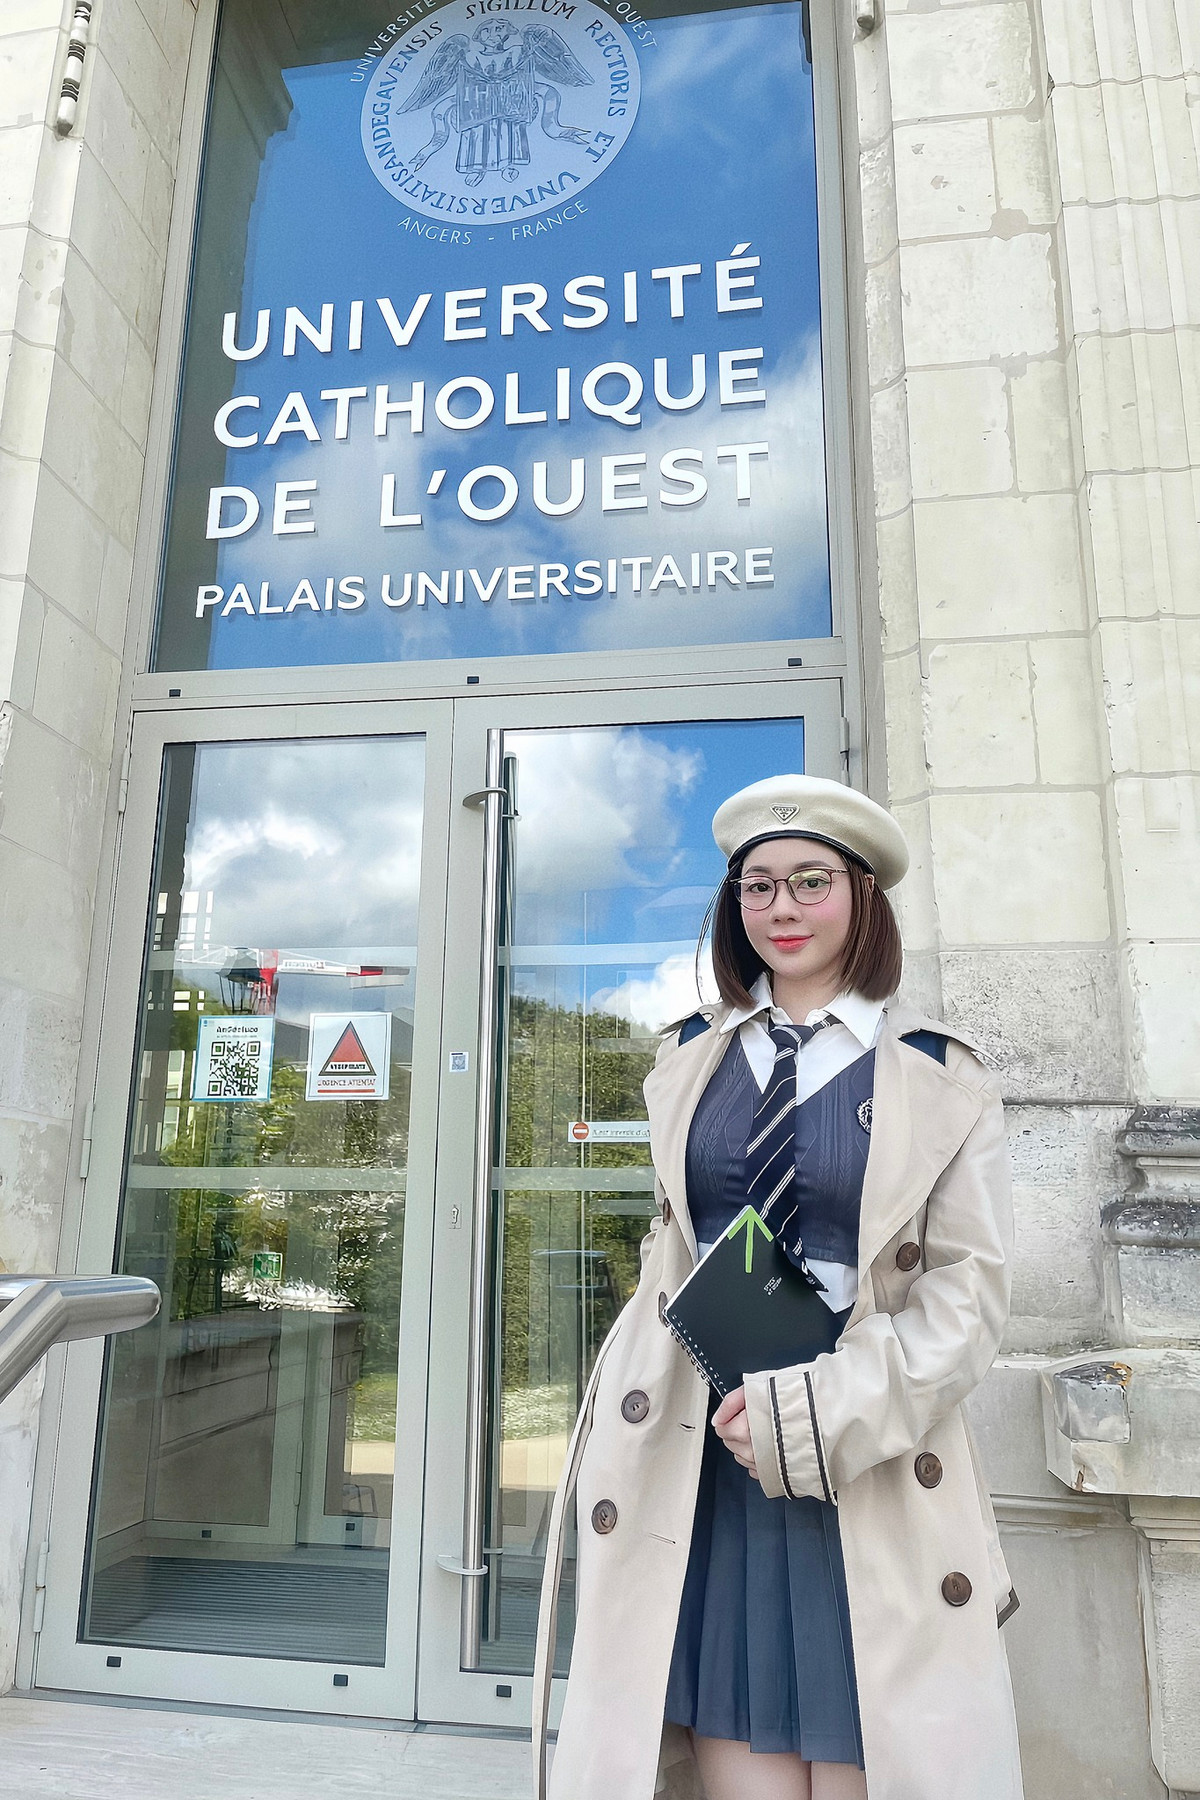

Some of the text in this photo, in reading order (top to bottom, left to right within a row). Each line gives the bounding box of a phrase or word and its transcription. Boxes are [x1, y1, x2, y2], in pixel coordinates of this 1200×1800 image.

[584, 19, 630, 118] RECTORIS
[586, 131, 616, 163] ET
[398, 216, 474, 245] ANGERS
[512, 200, 589, 241] FRANCE
[221, 242, 764, 362] UNIVERSITÉ
[213, 346, 767, 448] CATHOLIQUE
[205, 441, 769, 540] DE L'OUEST
[195, 547, 775, 618] PALAIS UNIVERSITAIRE
